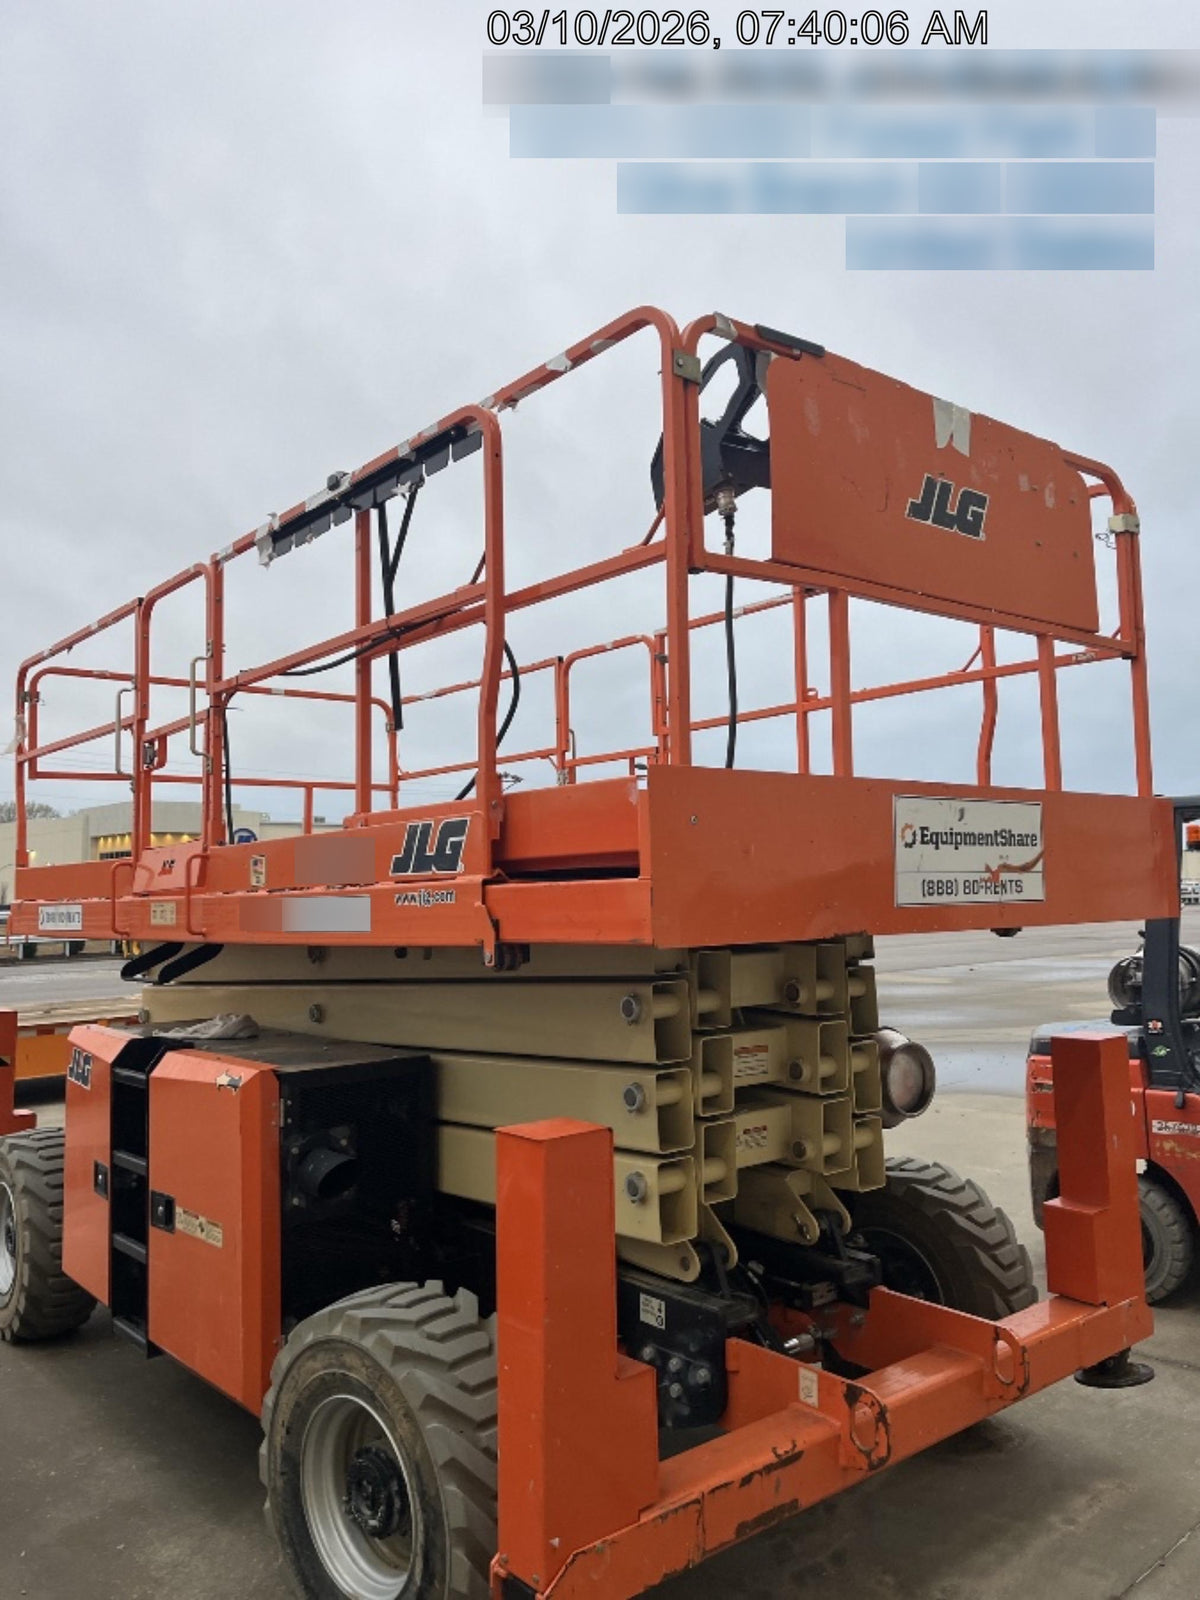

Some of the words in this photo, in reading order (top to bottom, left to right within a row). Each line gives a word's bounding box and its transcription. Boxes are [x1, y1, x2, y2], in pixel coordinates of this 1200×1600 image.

[905, 472, 989, 541] JLG
[389, 816, 471, 877] JLG
[919, 826, 1038, 850] EquipmentShare
[922, 878, 958, 897] (888)
[67, 1047, 92, 1090] JLG
